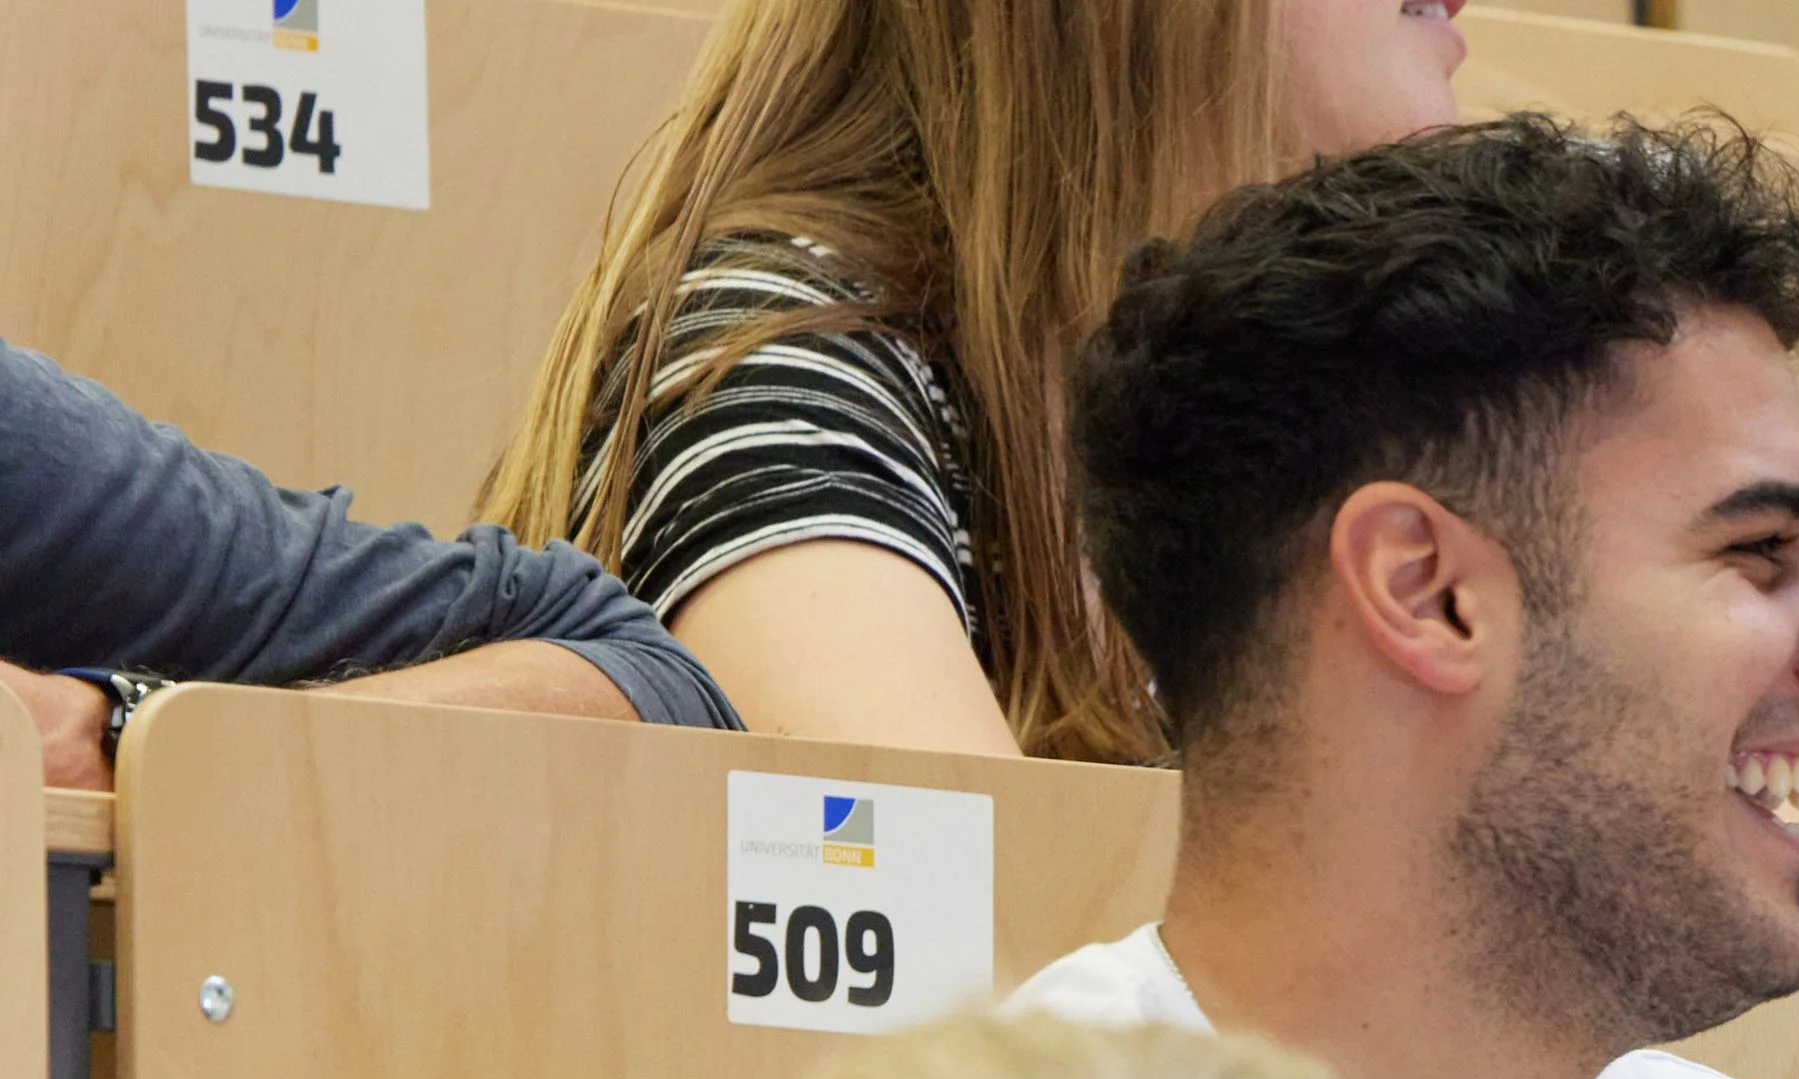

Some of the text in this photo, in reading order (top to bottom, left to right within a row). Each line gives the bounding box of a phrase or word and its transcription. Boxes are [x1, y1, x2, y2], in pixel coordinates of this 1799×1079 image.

[194, 79, 341, 174] 534
[740, 839, 862, 864] UNIVERSITÄT BONN
[732, 900, 895, 1007] 509
